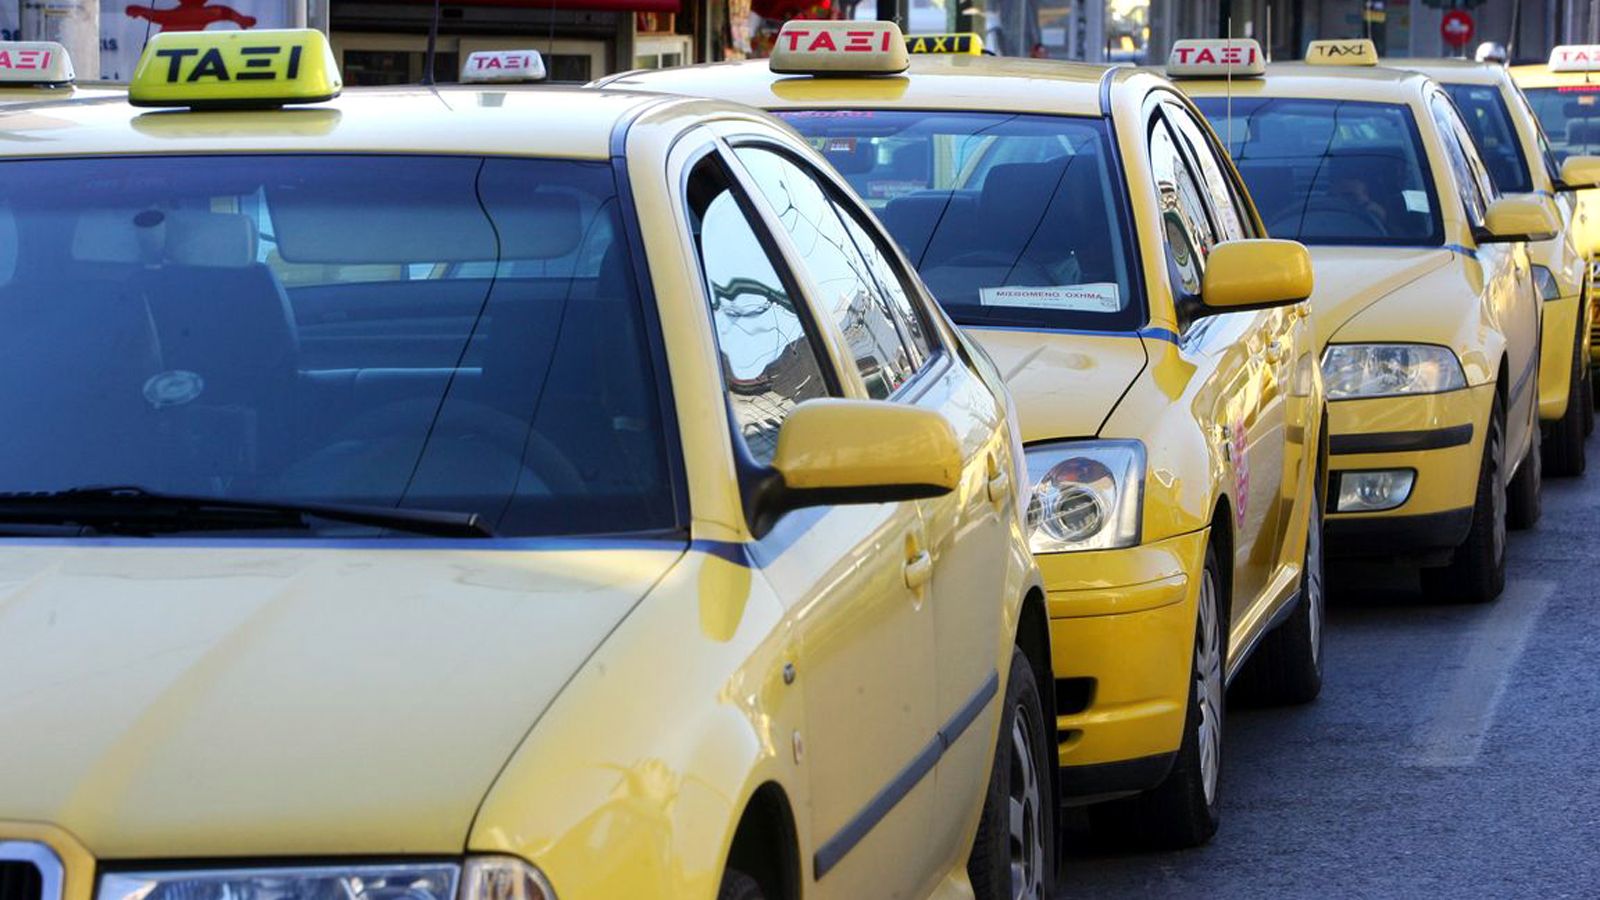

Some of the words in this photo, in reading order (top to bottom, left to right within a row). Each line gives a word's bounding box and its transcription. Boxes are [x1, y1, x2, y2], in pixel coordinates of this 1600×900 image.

[782, 31, 891, 51] ΤΑΞΙ
[1175, 47, 1256, 65] ΤΑΞΙ
[1315, 44, 1367, 57] TAXI
[155, 45, 303, 83] ΤΑΞΙ
[473, 56, 530, 69] ΤΑΞΙ
